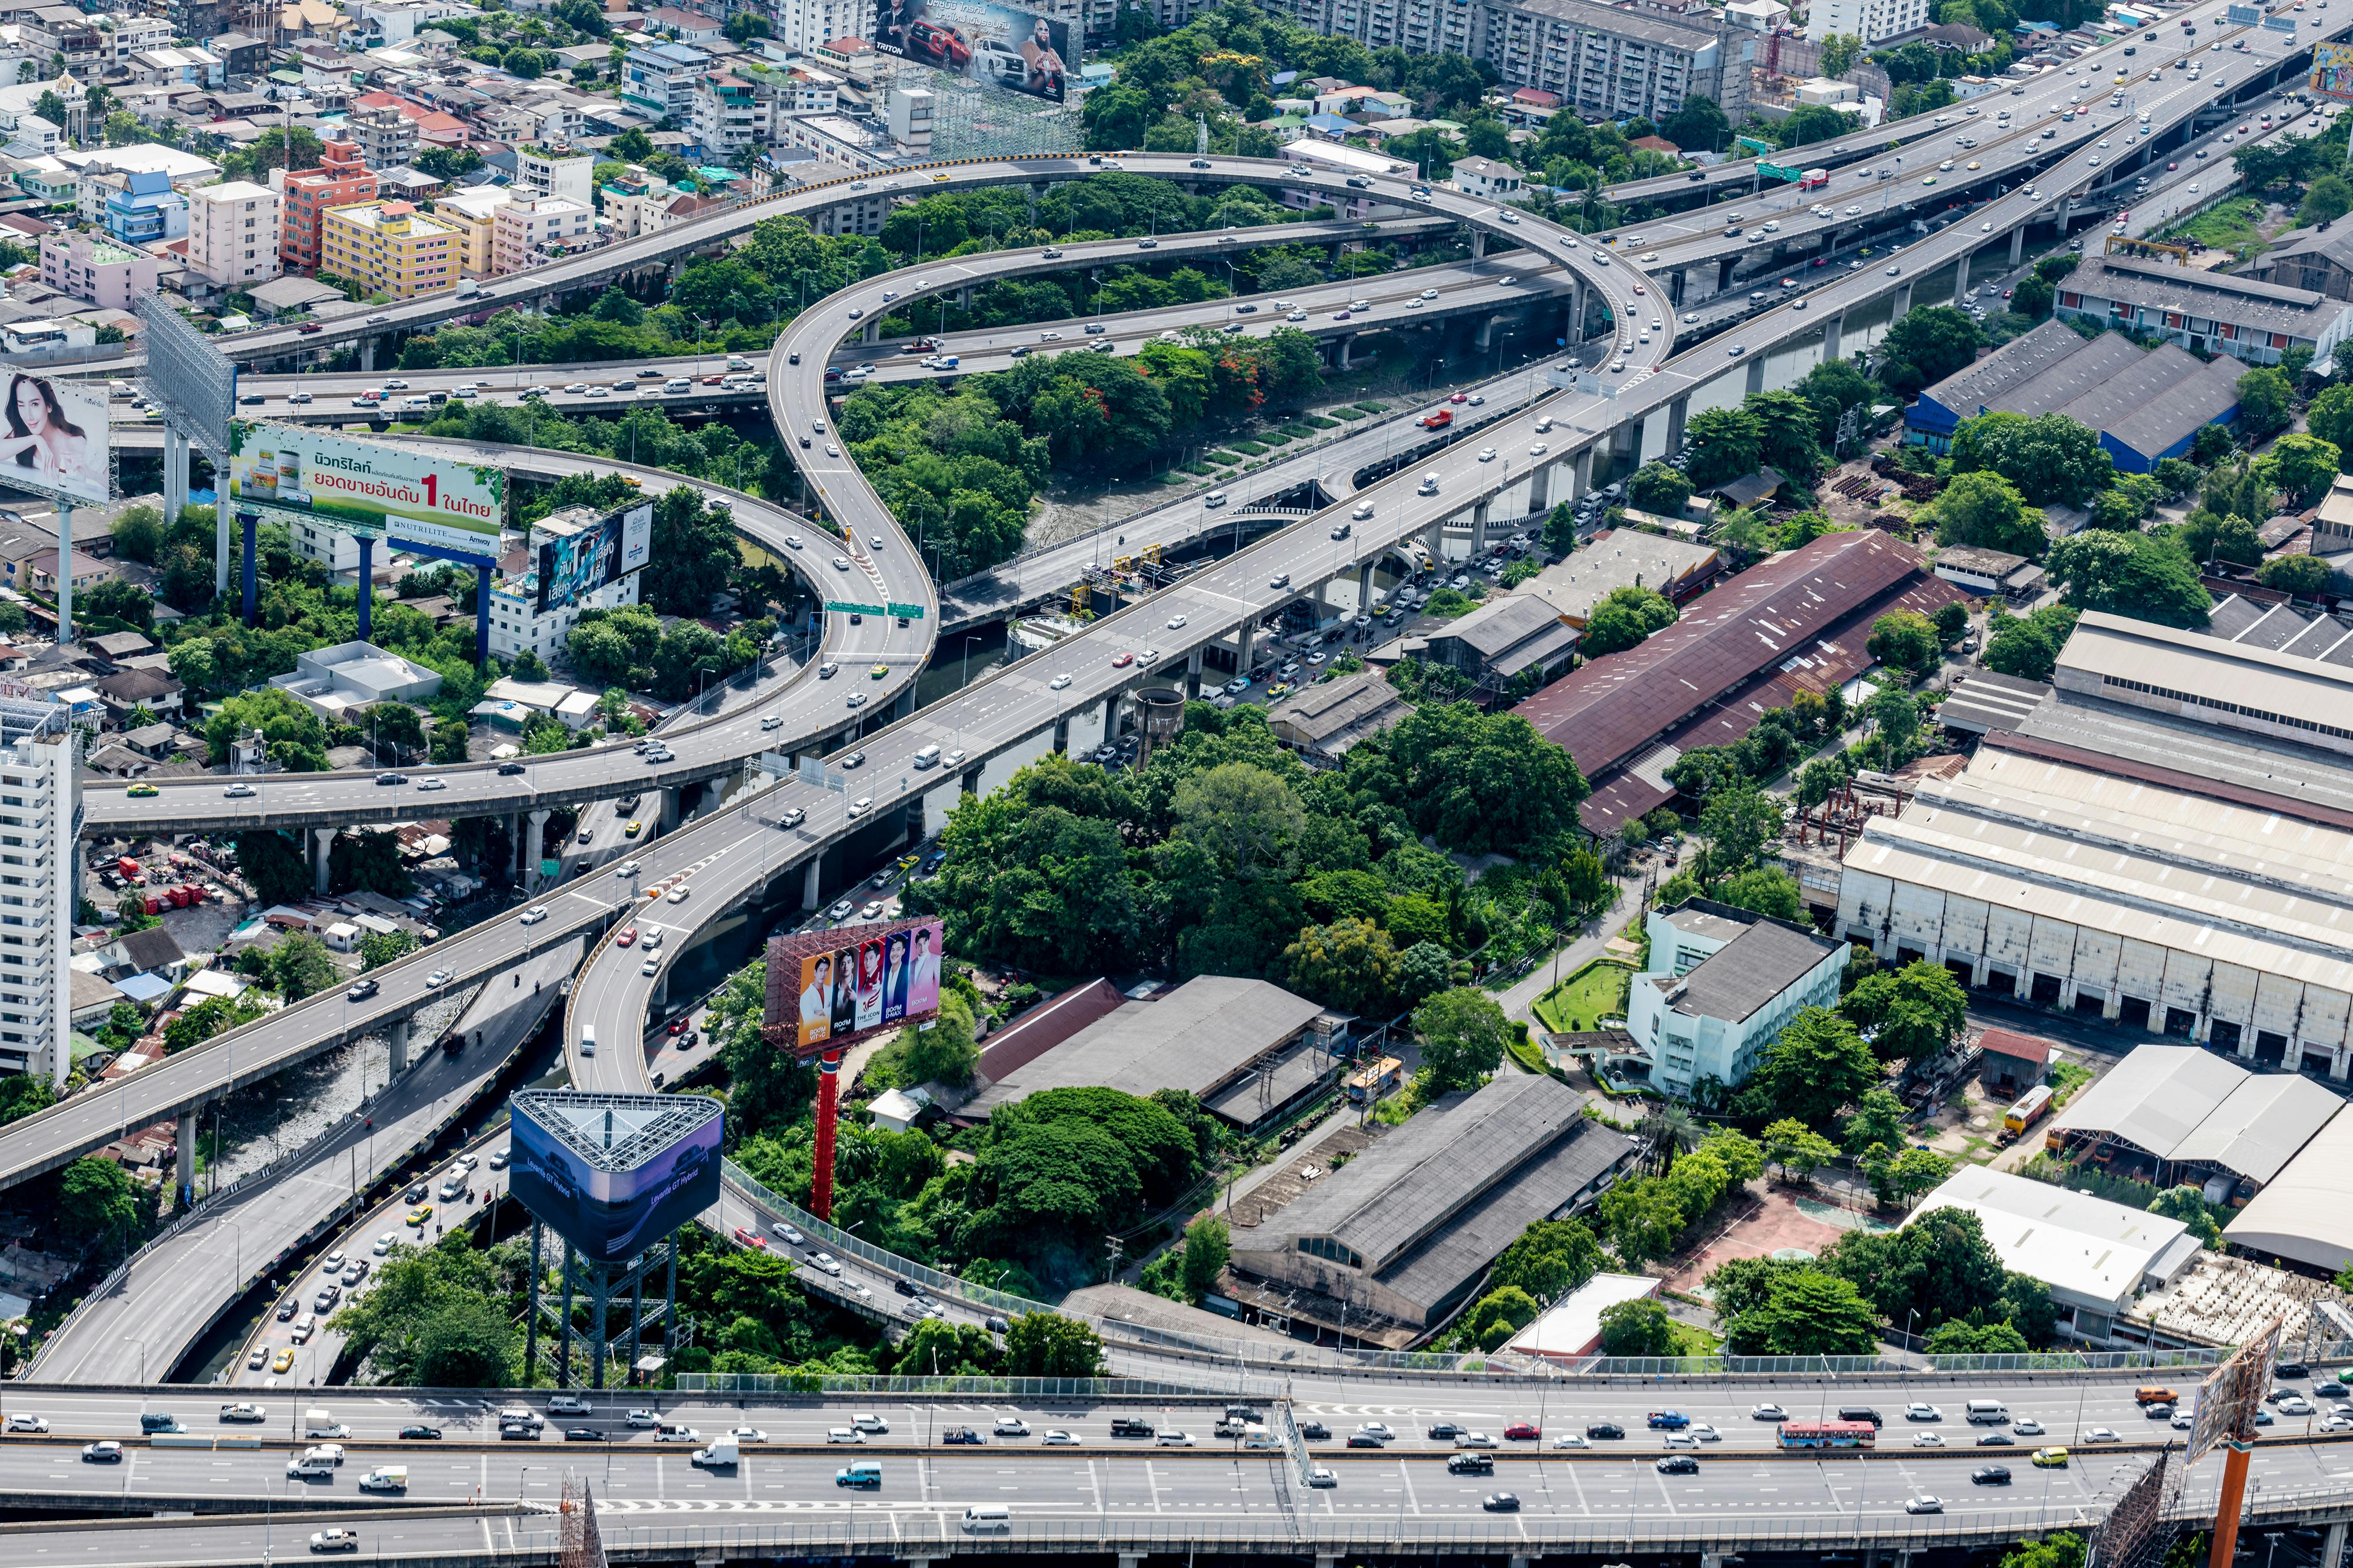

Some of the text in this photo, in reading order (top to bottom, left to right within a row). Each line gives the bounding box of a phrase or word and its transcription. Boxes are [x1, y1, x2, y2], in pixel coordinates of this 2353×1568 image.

[876, 41, 903, 55] TRITON
[315, 452, 372, 473] นิวทริไลท์
[315, 473, 419, 503] ยอดขายอันดับ
[421, 473, 437, 507] 1
[401, 522, 448, 537] NUTRILITE
[469, 536, 491, 546] Amway
[527, 1157, 570, 1198] Levante GT Hybrid
[651, 1169, 698, 1205] Levante GT Hybrid
